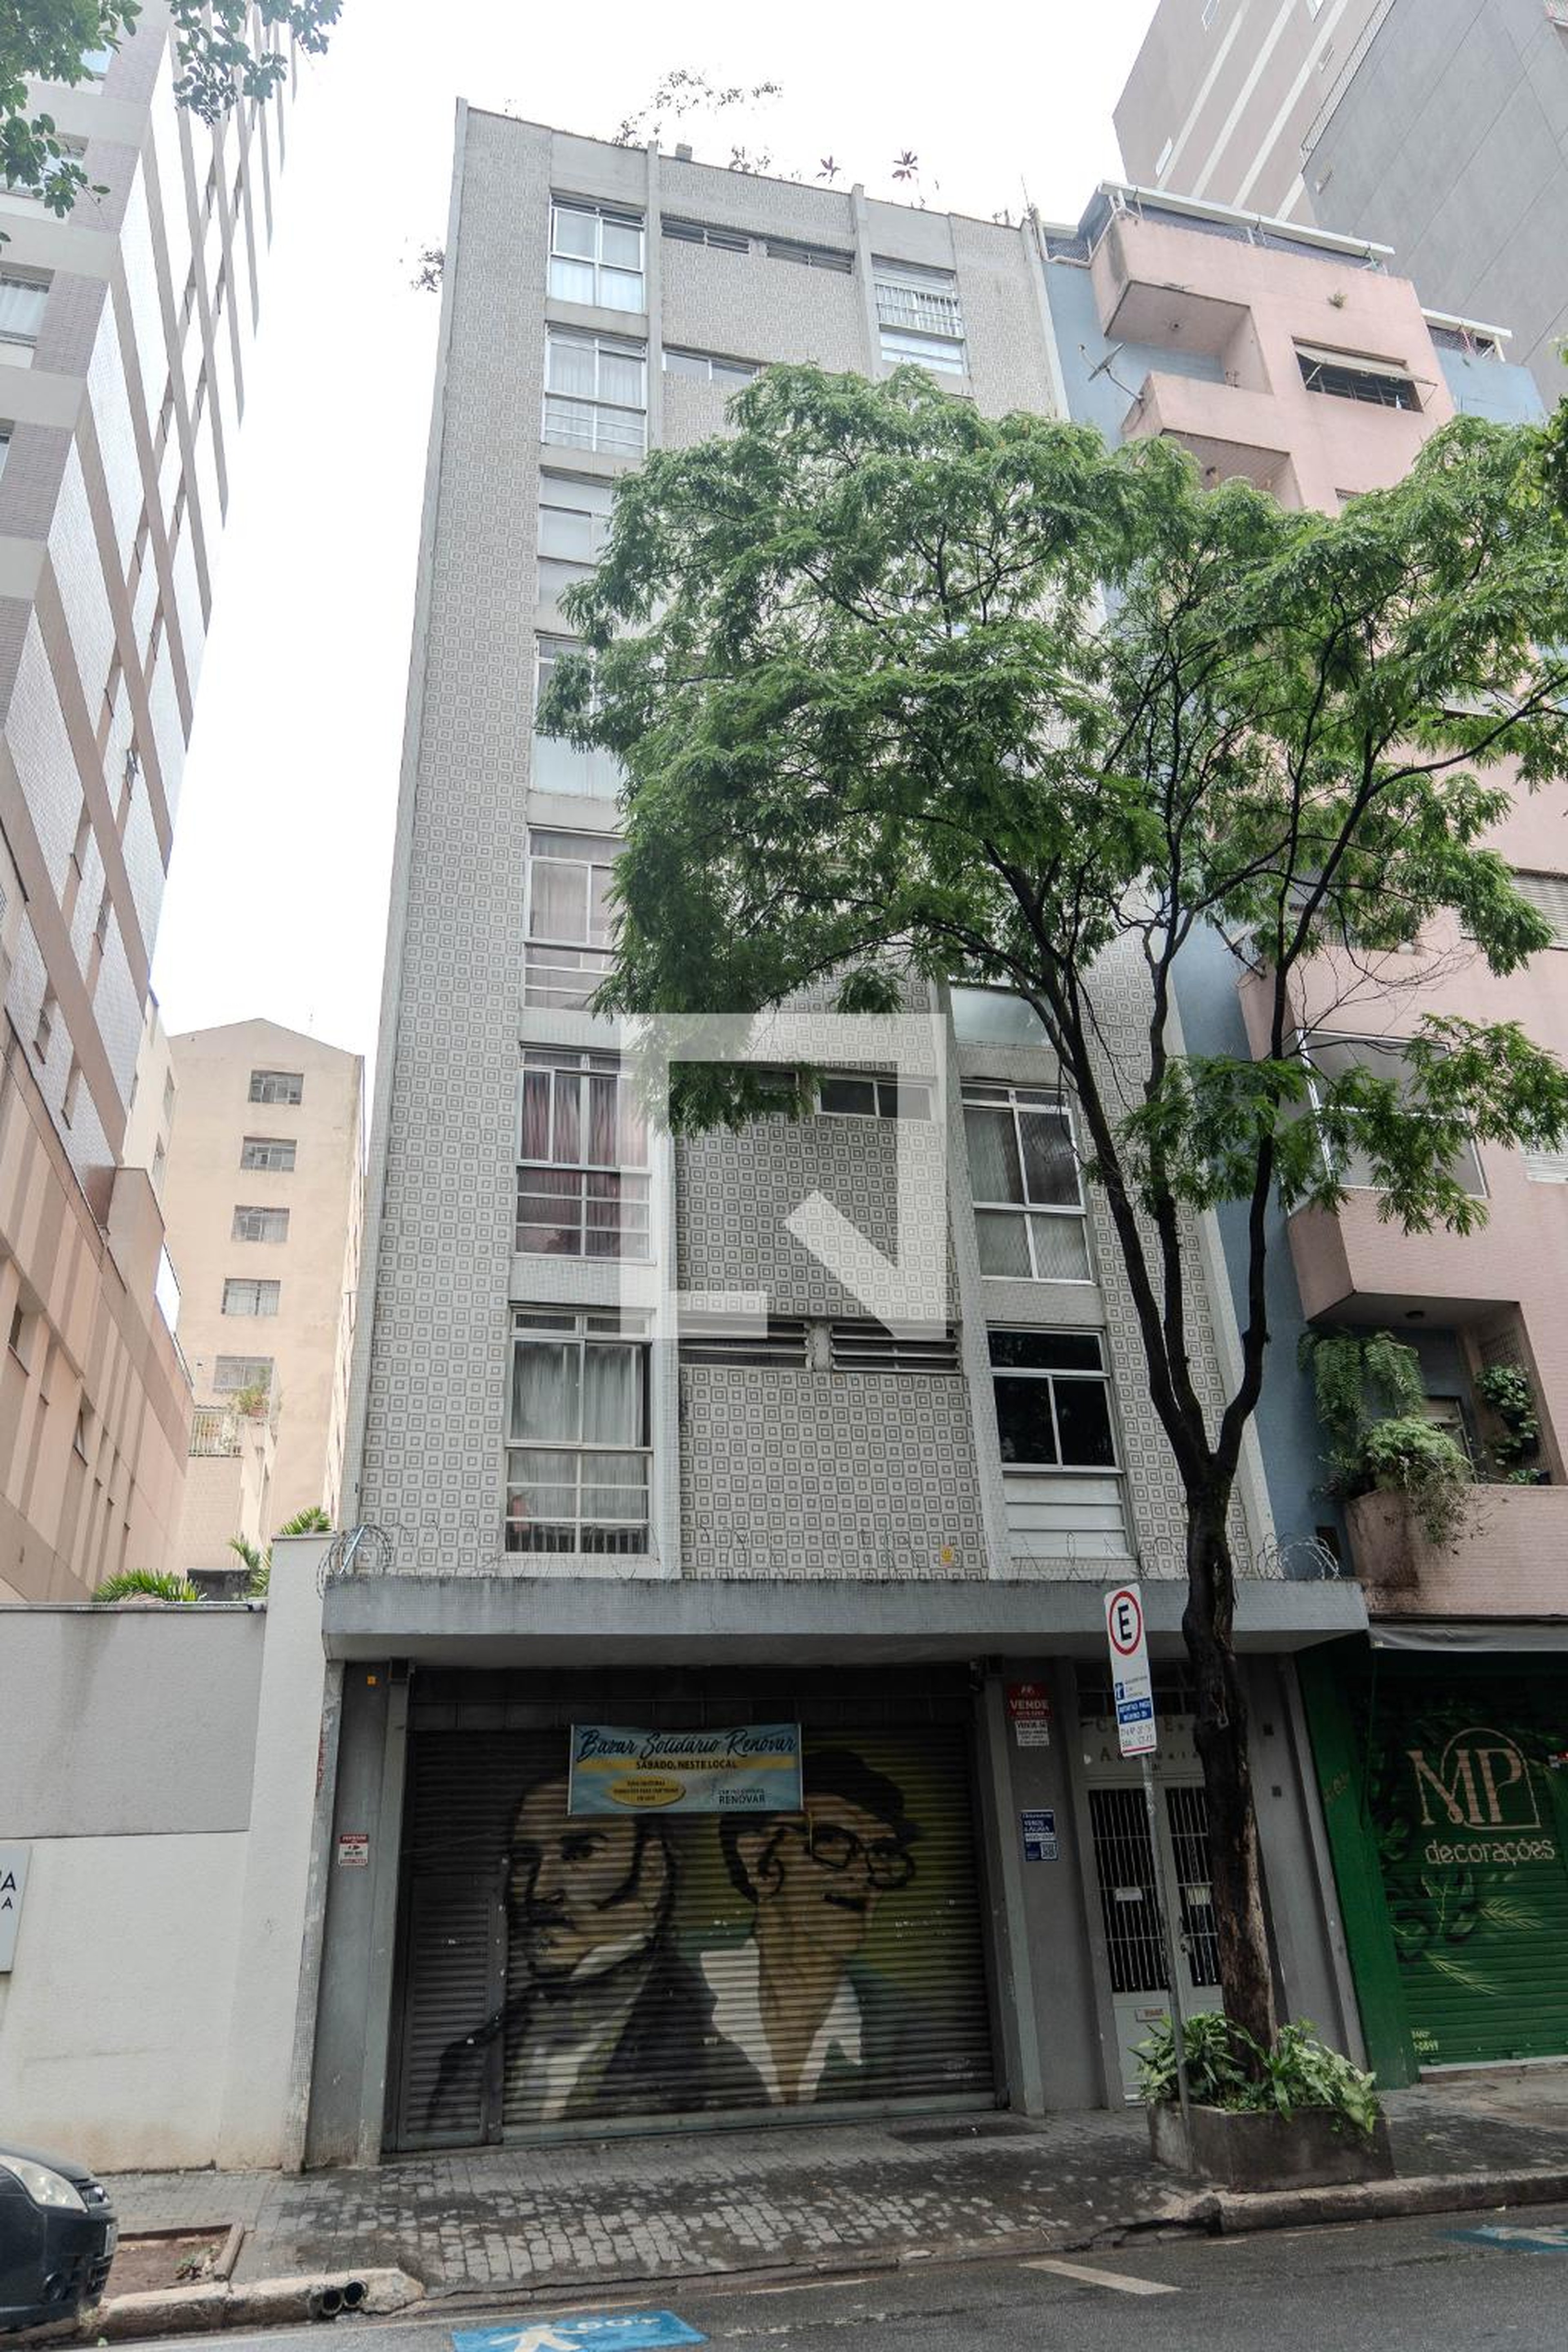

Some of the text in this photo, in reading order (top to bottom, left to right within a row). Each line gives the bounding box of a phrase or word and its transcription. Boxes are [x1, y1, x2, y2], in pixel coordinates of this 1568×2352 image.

[1118, 1604, 1131, 1641] E
[576, 1729, 637, 1762] Bazar
[726, 1729, 796, 1757] Renovar
[719, 1795, 765, 1804] RENOVAR
[1406, 1748, 1523, 1826] MP
[1425, 1839, 1555, 1866] decorações
[0, 1871, 16, 1891] A
